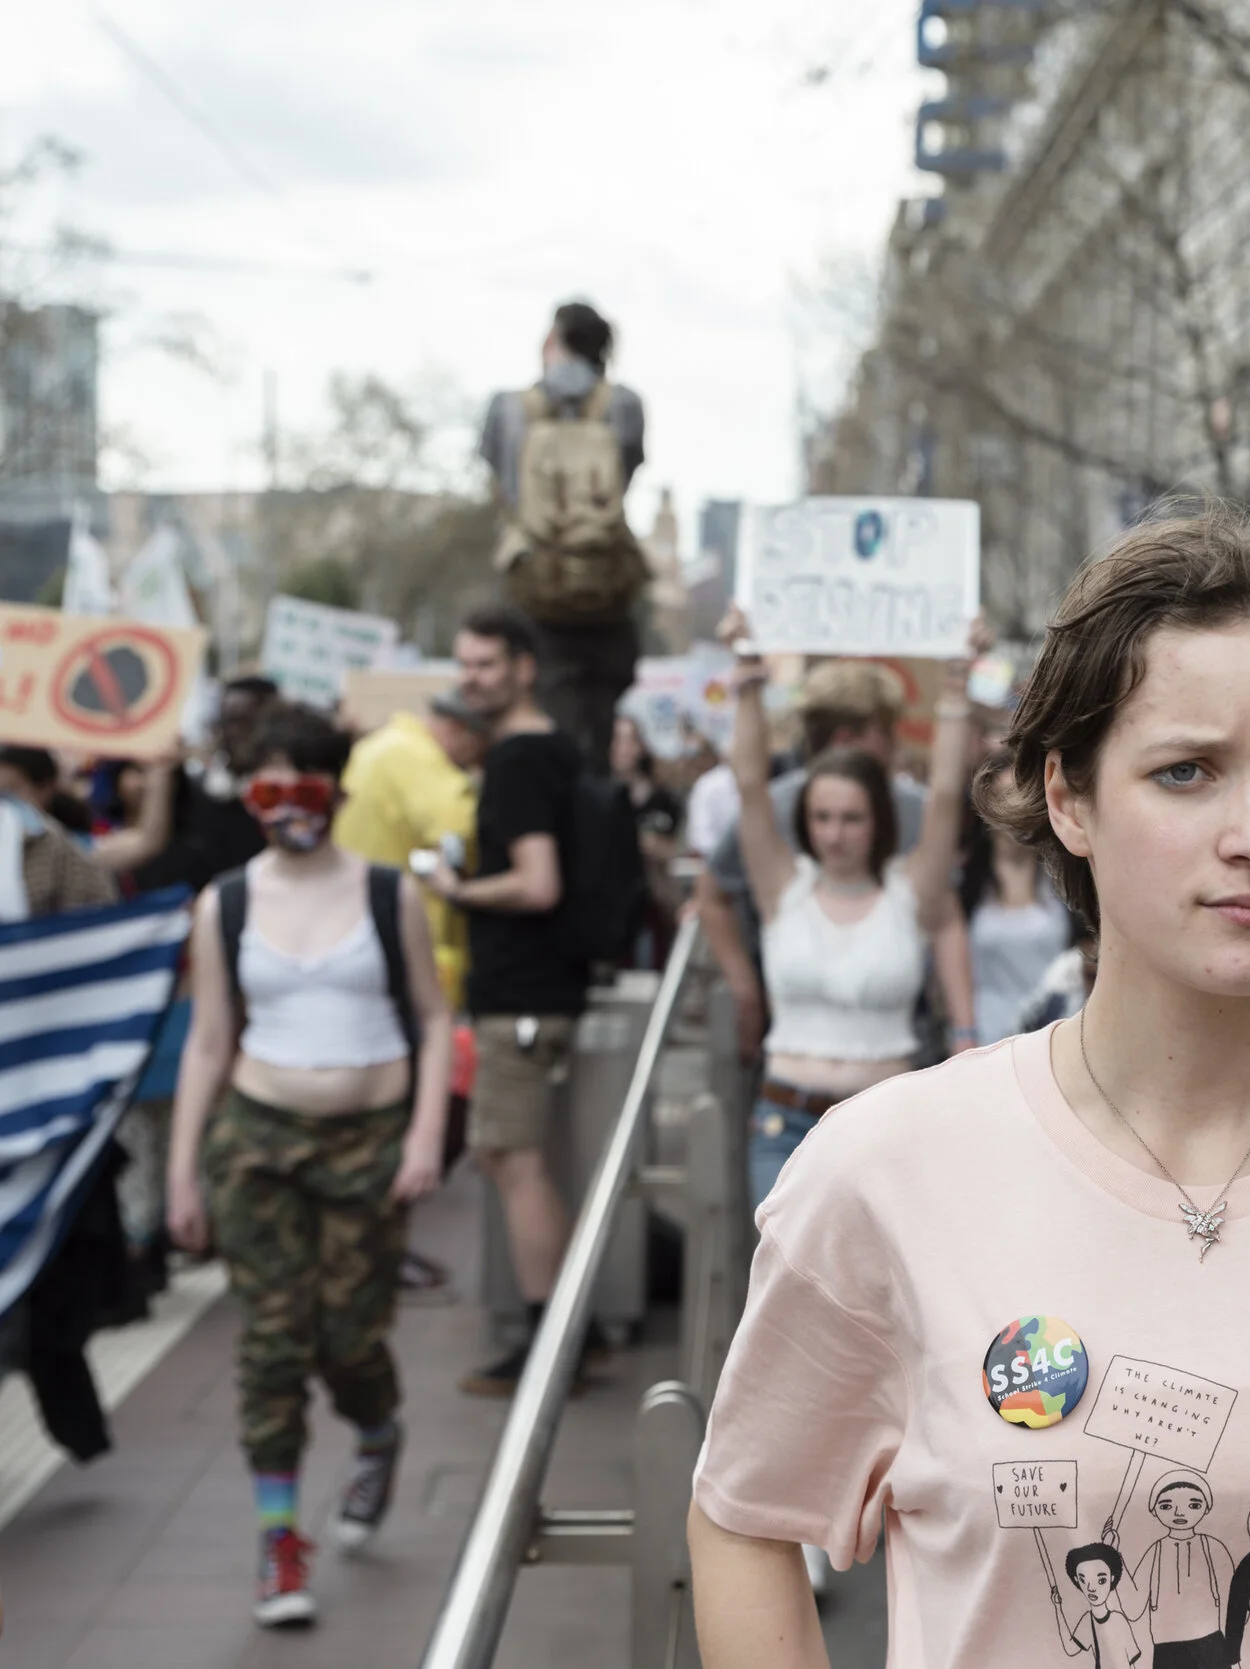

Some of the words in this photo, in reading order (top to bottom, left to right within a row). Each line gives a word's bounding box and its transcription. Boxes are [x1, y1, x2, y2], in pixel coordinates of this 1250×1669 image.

[757, 505, 940, 568] STOP
[990, 1338, 1074, 1393] SS4C
[997, 1389, 1020, 1401] School
[1021, 1380, 1042, 1392] Strike
[1050, 1367, 1077, 1380] Climate
[1125, 1368, 1149, 1382] THE
[1162, 1380, 1219, 1405] CLIMATE
[1112, 1404, 1140, 1418] WHY
[1148, 1416, 1197, 1437] AREN'T
[1115, 1386, 1124, 1394] IS
[1134, 1393, 1211, 1424] CHANGING
[1135, 1433, 1159, 1448] WE?
[1012, 1466, 1043, 1482] SAVE
[1014, 1484, 1039, 1498] OUR
[1011, 1503, 1057, 1517] FUTURE
